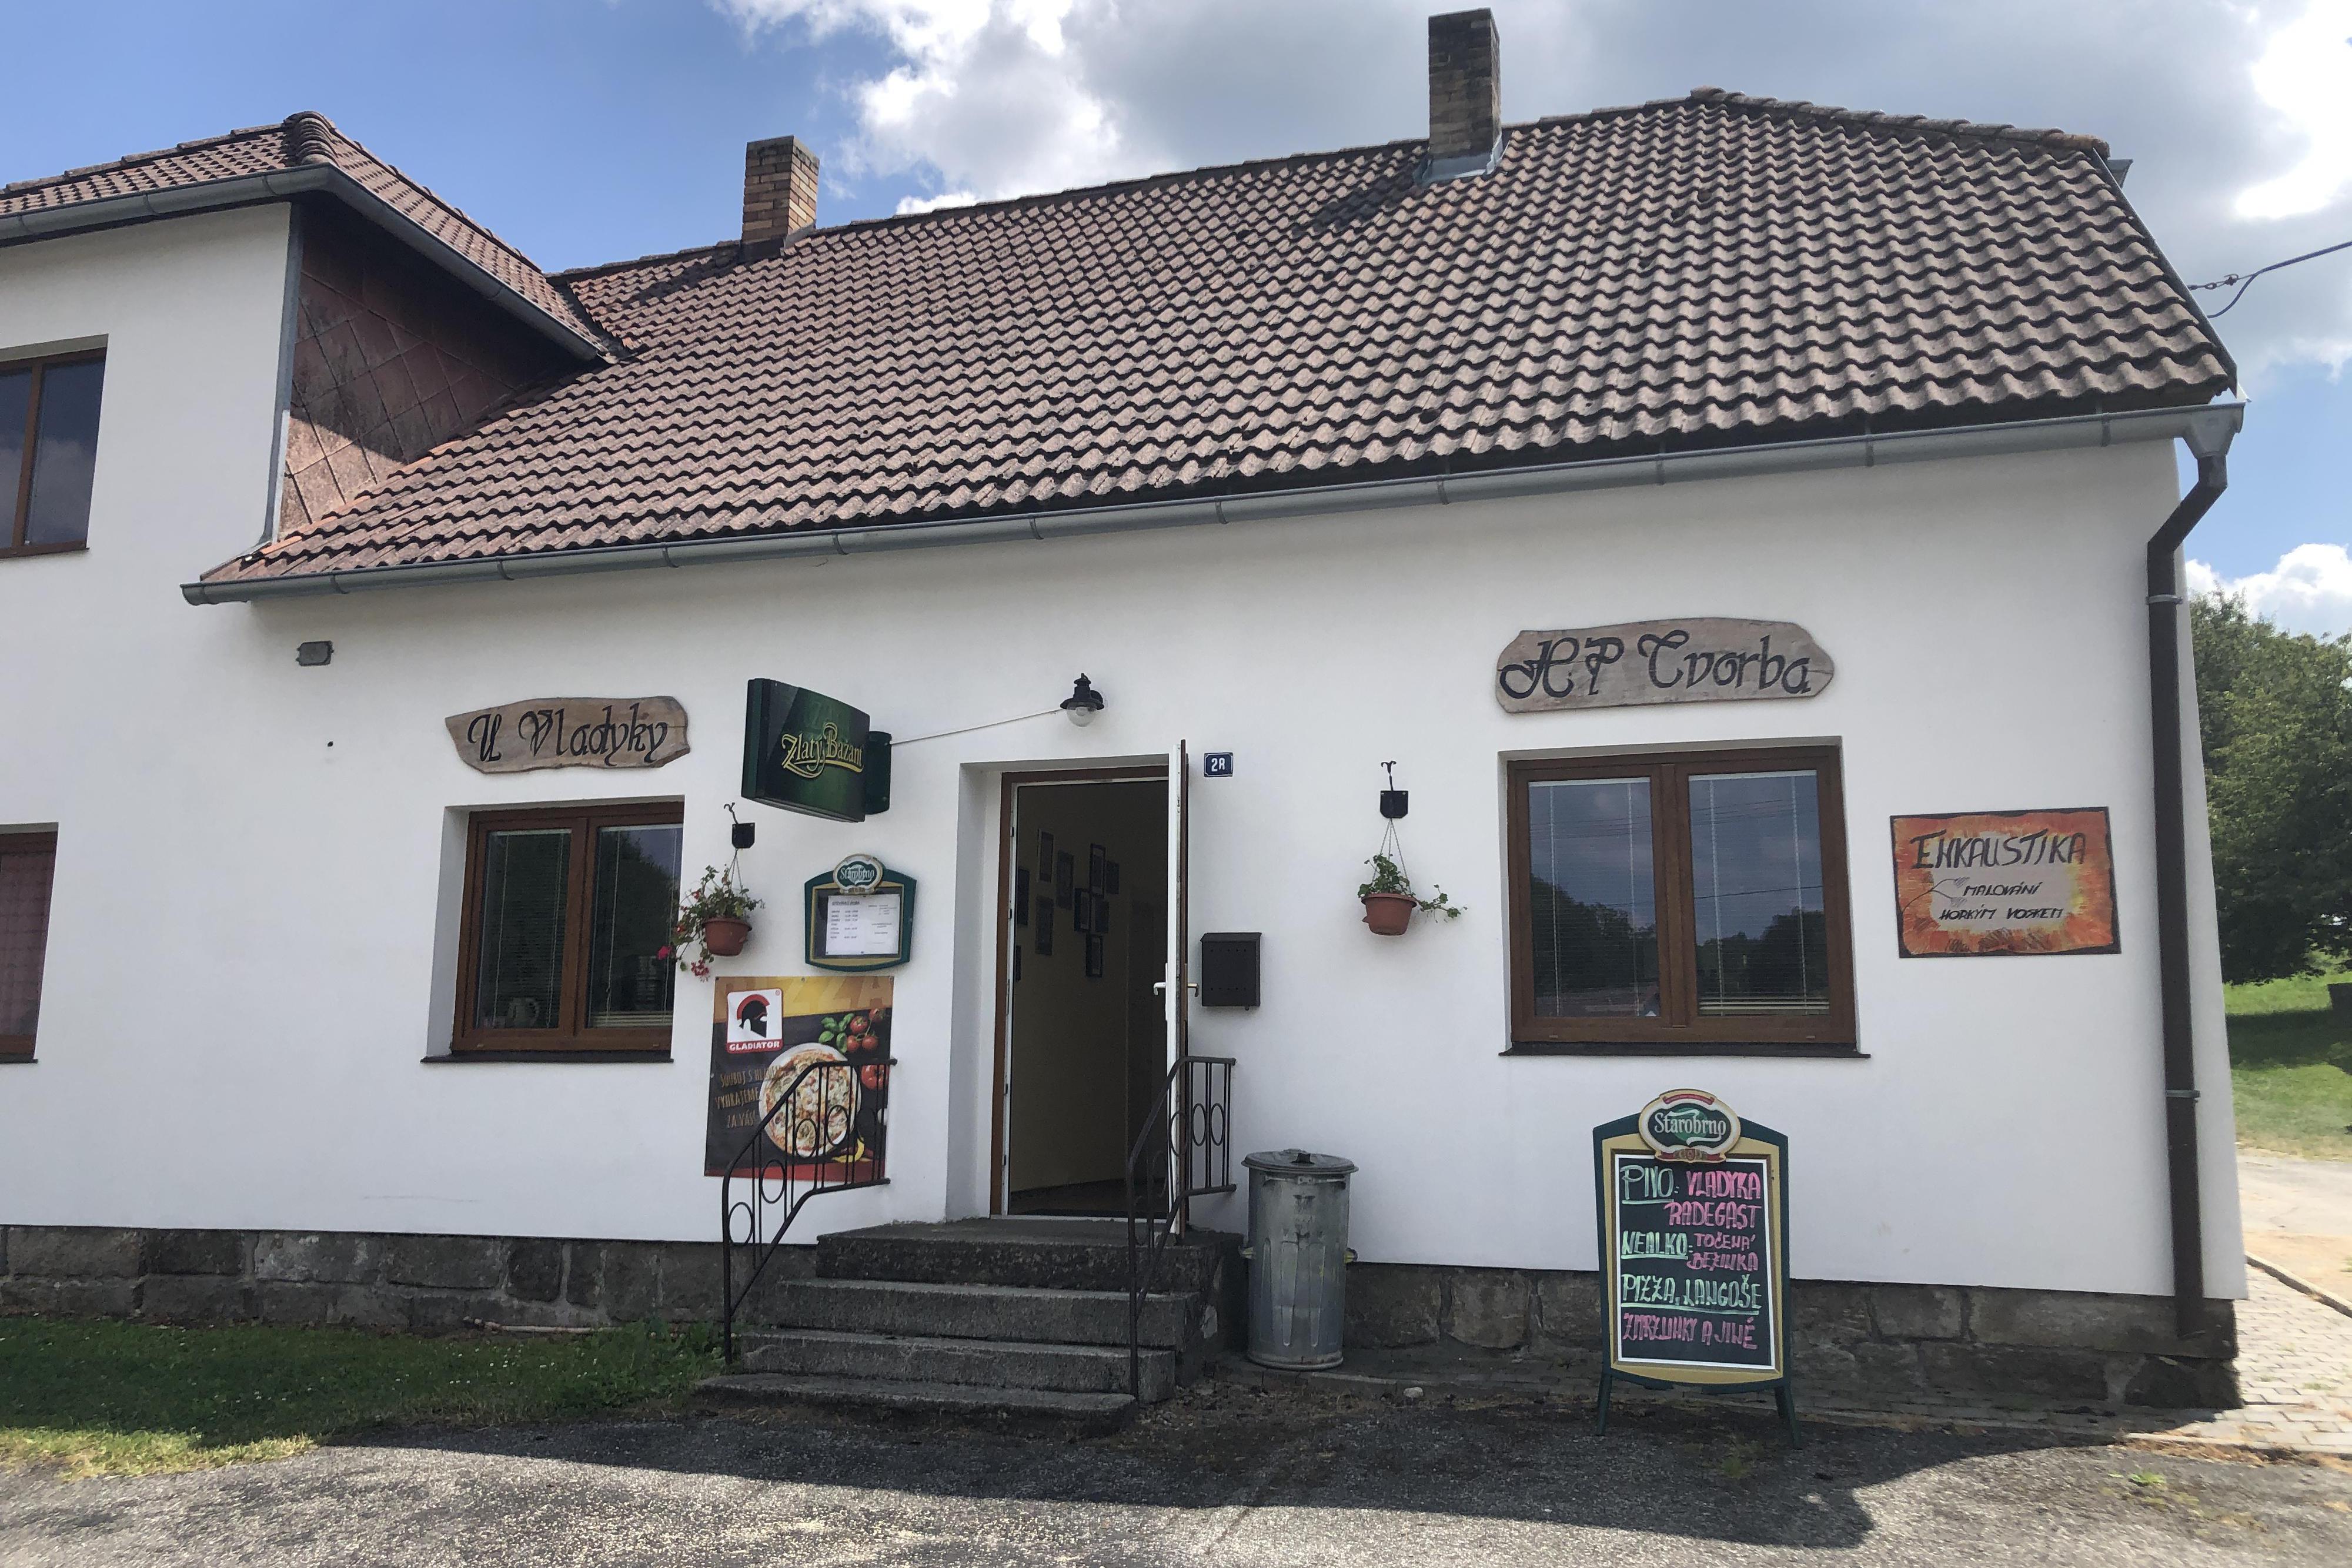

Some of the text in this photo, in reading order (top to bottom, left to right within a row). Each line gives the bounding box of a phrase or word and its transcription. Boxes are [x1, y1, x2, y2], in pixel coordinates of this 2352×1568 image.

[467, 702, 668, 767] U Vladyky
[781, 722, 863, 778] Zlatý Bažant
[1211, 757, 1225, 772] 2A
[1909, 828, 2086, 870] ENKAUSTIKA
[1962, 881, 2043, 897] MALOVÁNÍ
[1939, 904, 2064, 920] HORKÝM VOSKEM
[729, 1041, 780, 1051] GLADIATOR
[1654, 1109, 1726, 1145] Starobrno
[1686, 1171, 1762, 1199] VLADYKA
[1663, 1201, 1762, 1229] RADEGAST
[1683, 1273, 1762, 1309] LANGOŠE
[1701, 1320, 1713, 1346] A
[1714, 1316, 1758, 1349] JINÉ
